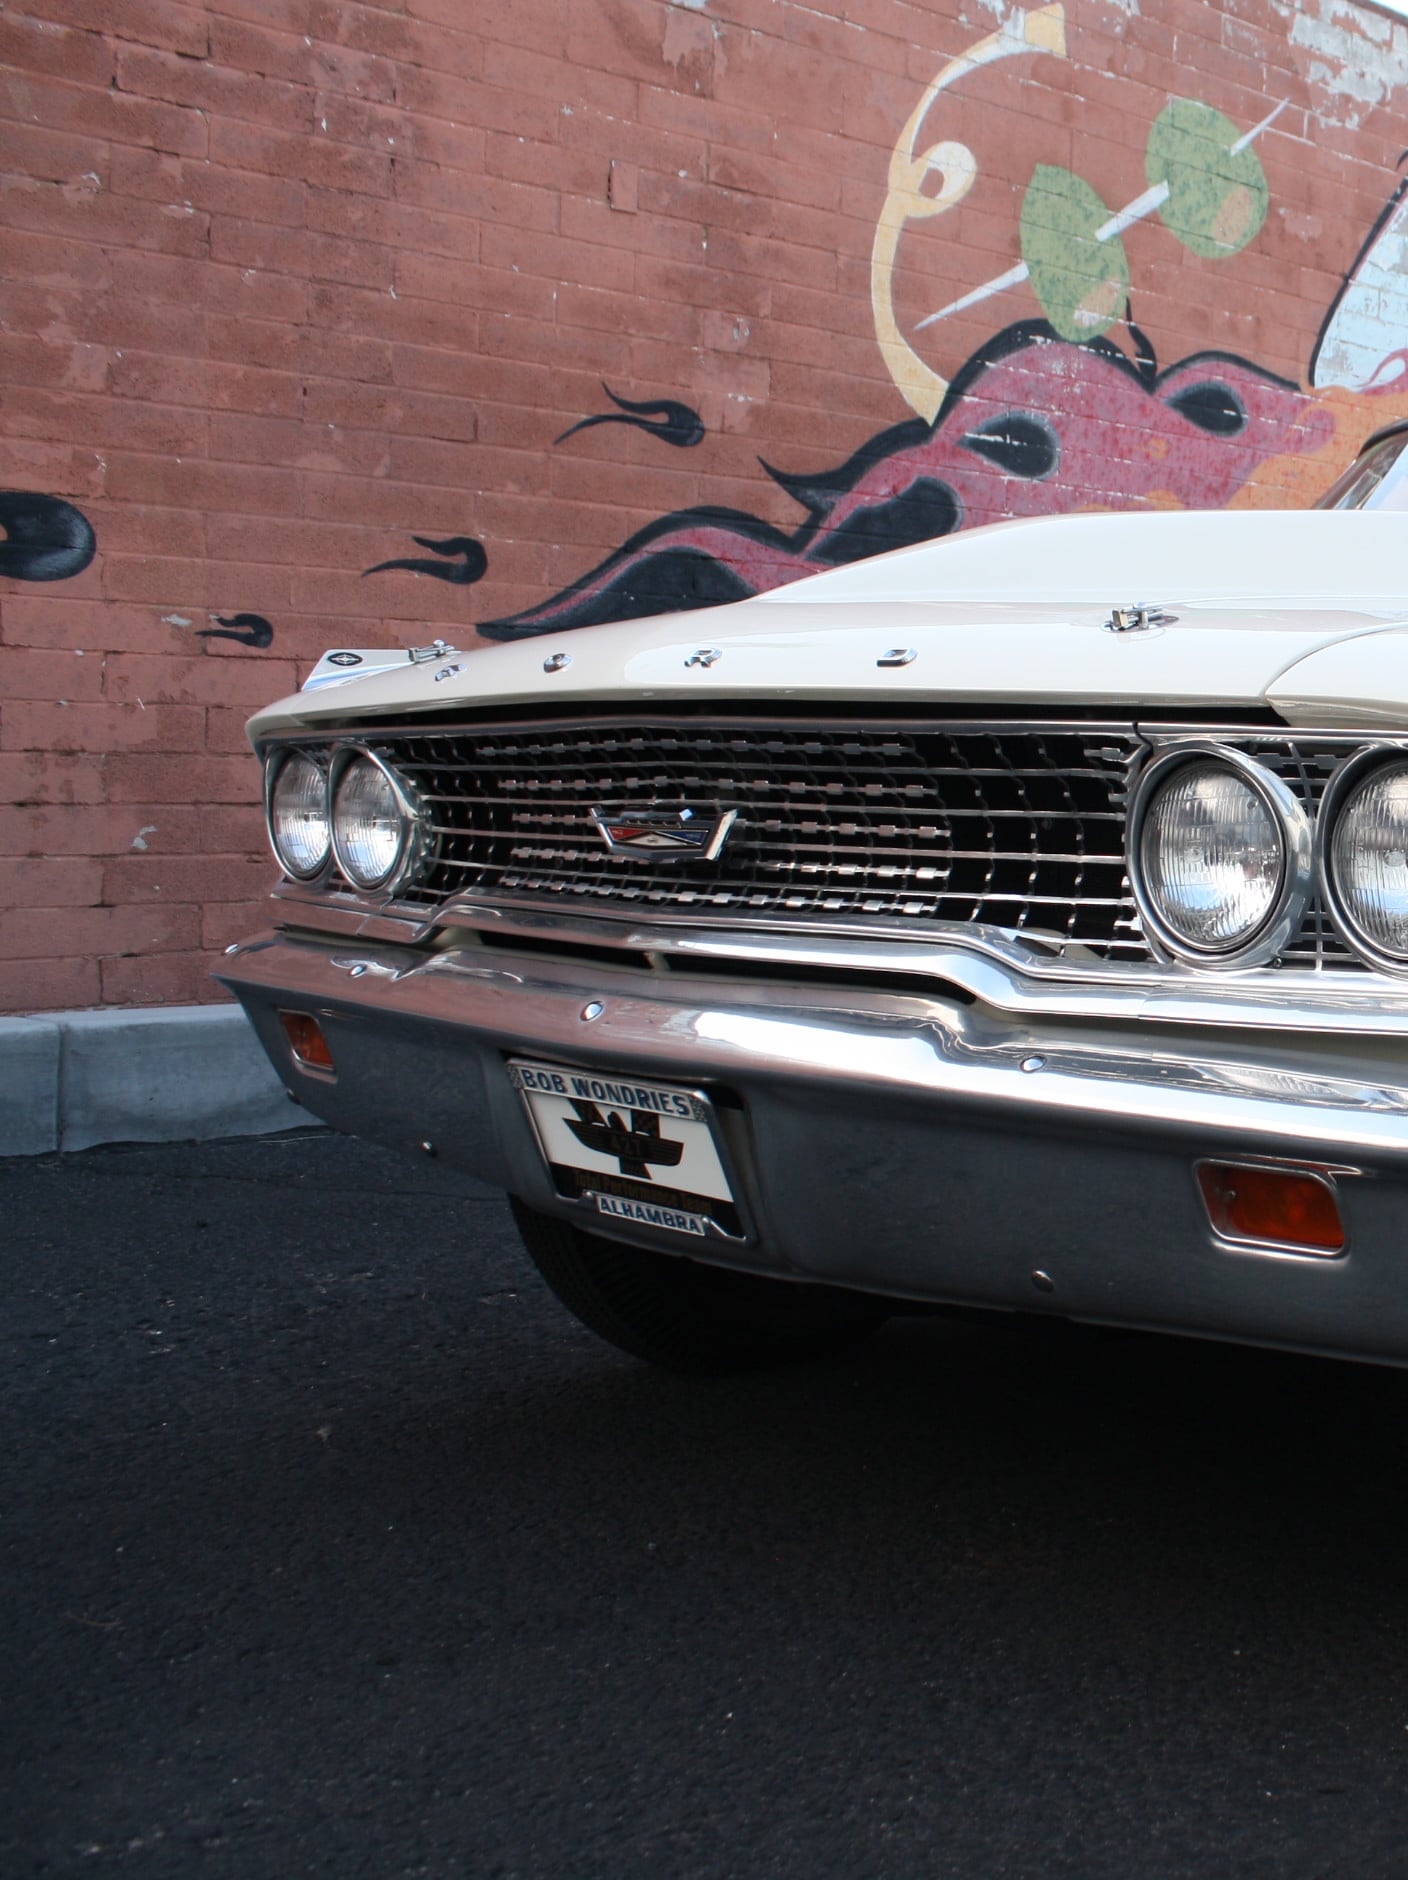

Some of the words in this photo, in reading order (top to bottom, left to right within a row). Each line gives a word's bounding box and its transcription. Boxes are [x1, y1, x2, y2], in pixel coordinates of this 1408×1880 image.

[520, 1068, 568, 1094] BOB
[571, 1076, 691, 1117] WONDRIES
[600, 1197, 700, 1233] ALHAMBRA
